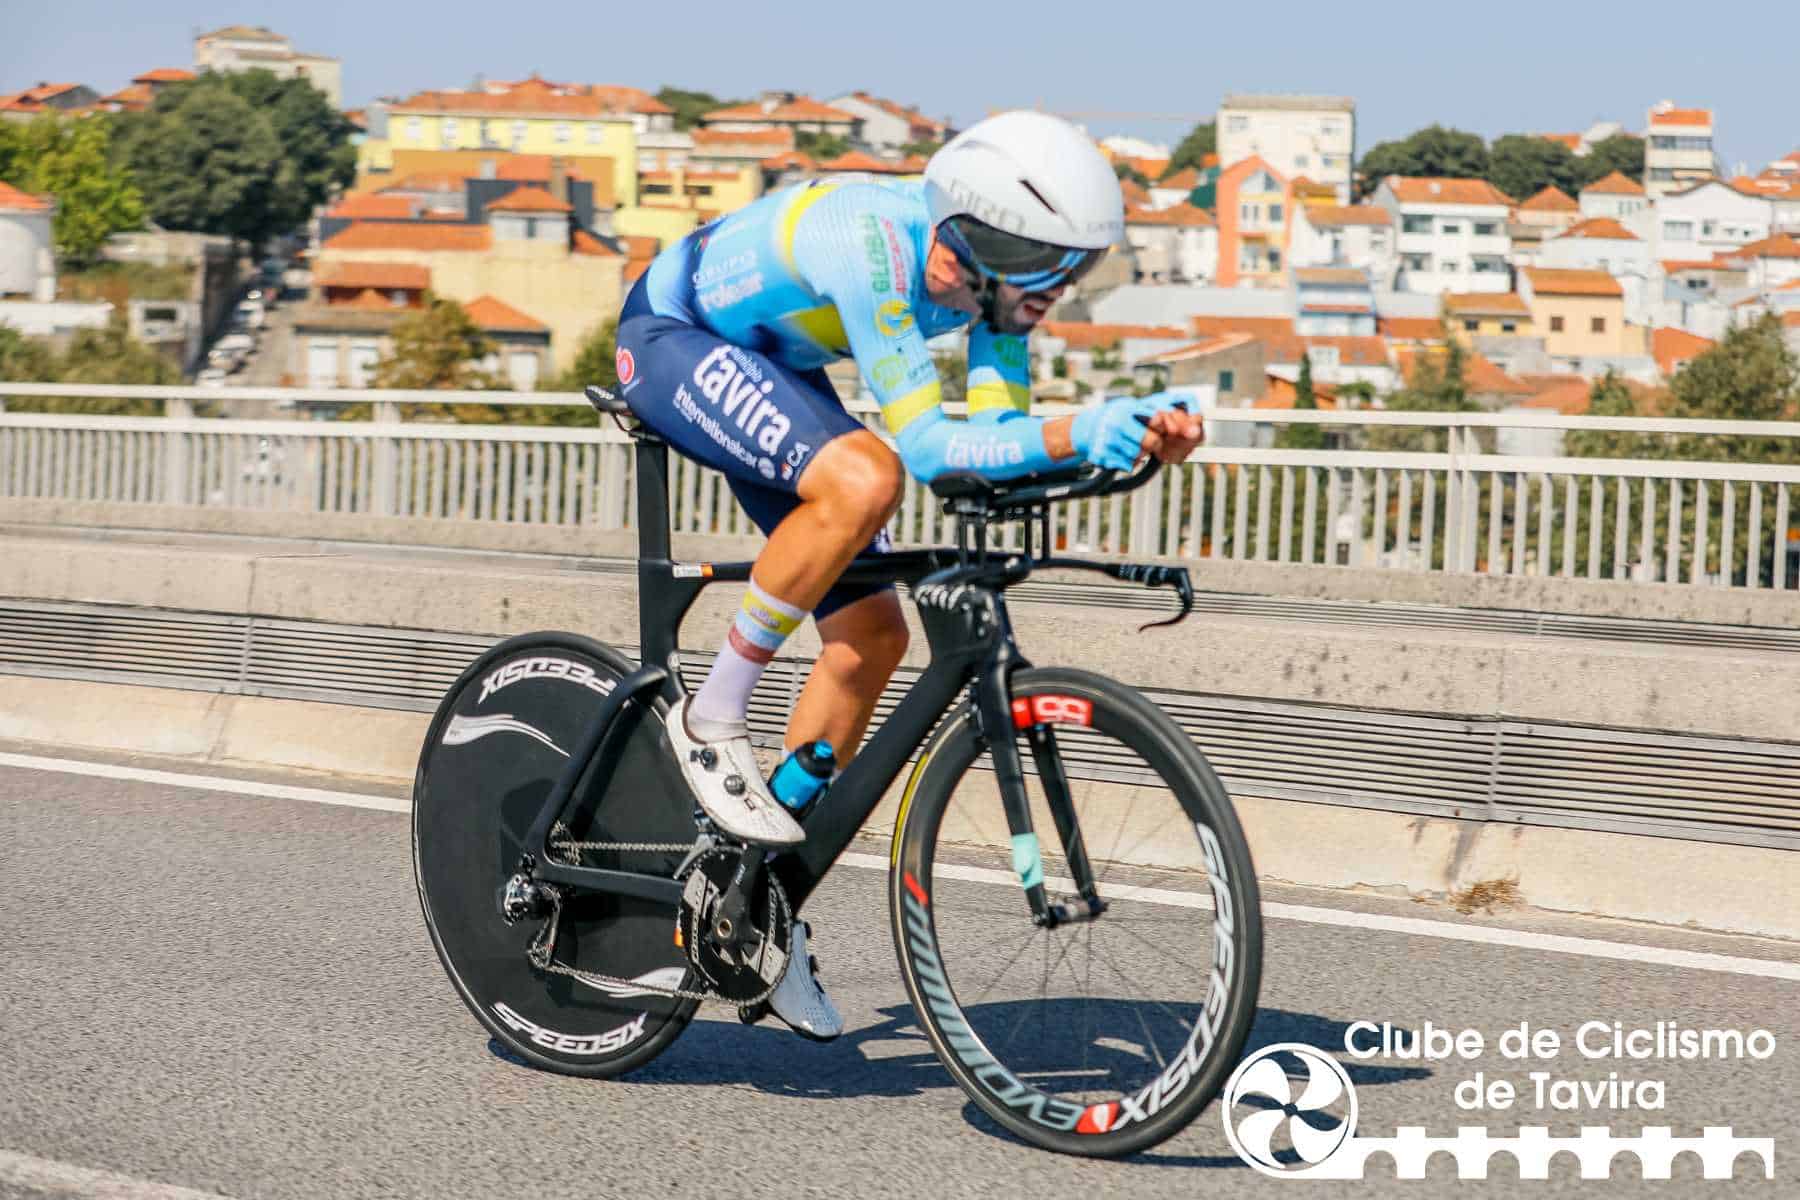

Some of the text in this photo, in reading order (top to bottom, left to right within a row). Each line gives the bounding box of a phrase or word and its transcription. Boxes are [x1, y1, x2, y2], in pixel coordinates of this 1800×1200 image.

[693, 344, 791, 456] tavira
[945, 432, 1025, 468] tavira
[489, 1001, 648, 1056] SPEEDSIX
